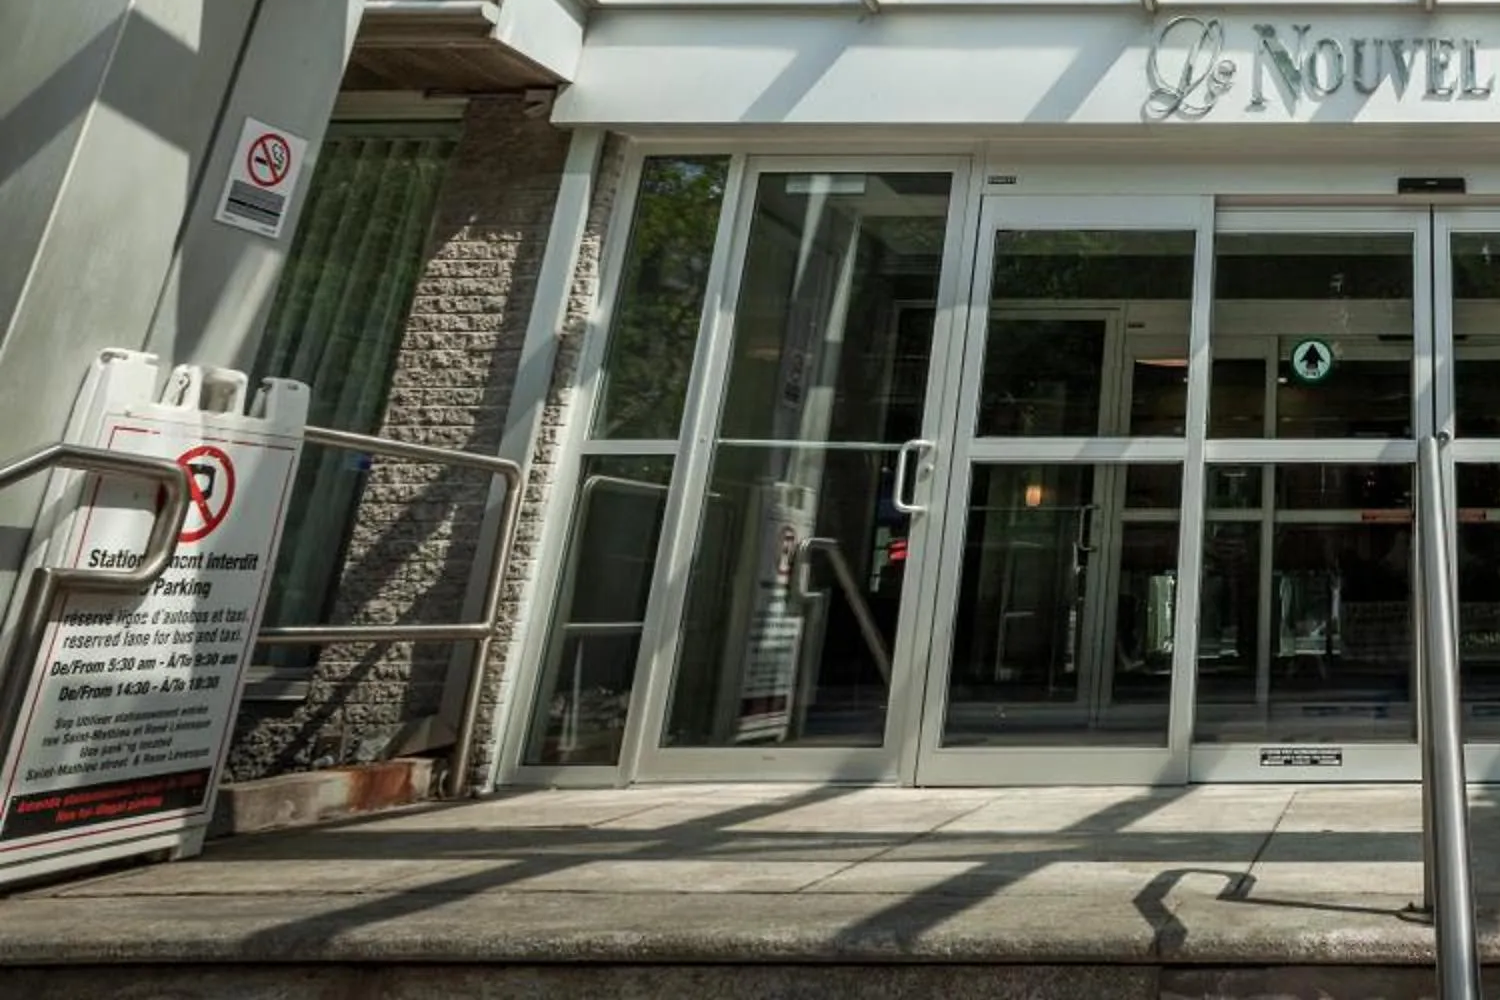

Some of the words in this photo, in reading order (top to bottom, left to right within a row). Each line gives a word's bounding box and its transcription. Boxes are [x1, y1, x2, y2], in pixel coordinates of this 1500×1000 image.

[1144, 15, 1237, 119] Le
[1246, 23, 1494, 113] NOUVEL
[153, 578, 212, 598] Parking
[153, 629, 171, 645] for
